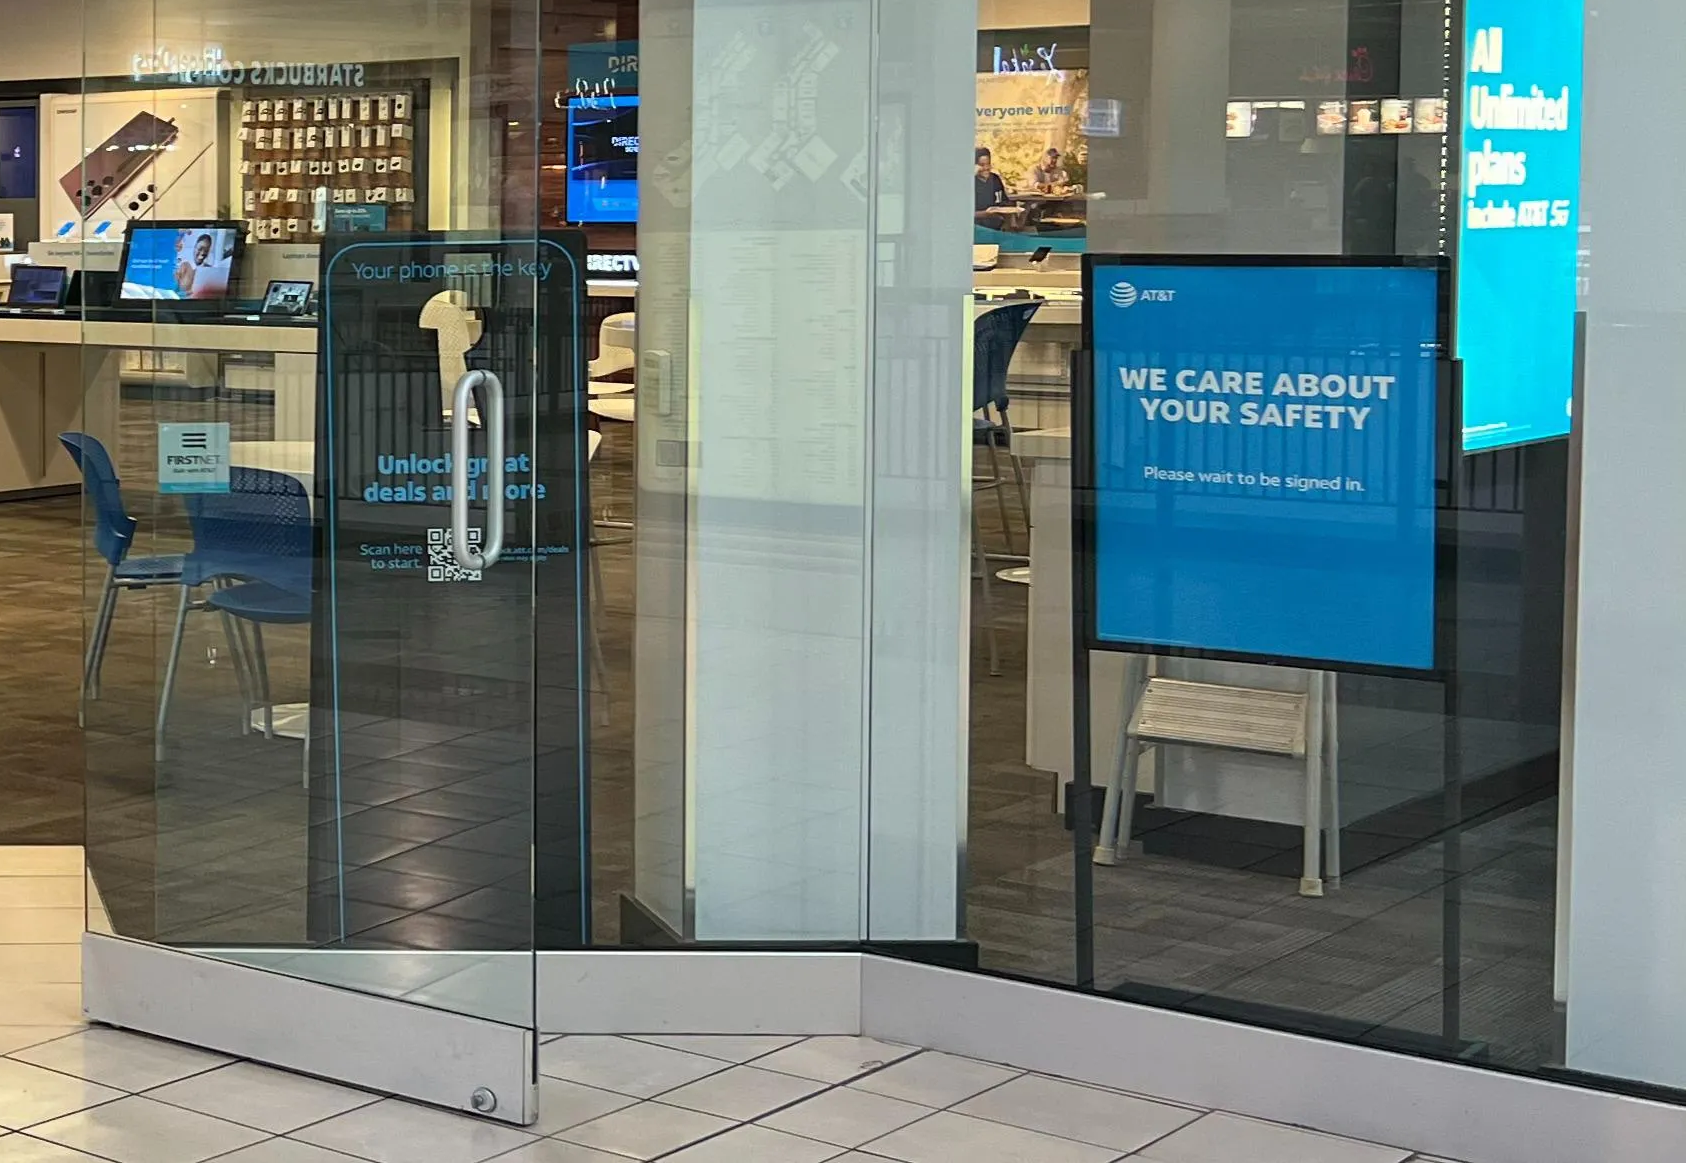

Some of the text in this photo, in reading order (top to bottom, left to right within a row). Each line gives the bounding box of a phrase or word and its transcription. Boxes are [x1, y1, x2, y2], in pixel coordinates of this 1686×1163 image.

[1470, 26, 1503, 73] All
[976, 103, 1071, 120] veryone wins
[1470, 83, 1569, 131] Unlimited
[1468, 138, 1527, 198] plans
[351, 260, 552, 282] Your phone is the key
[1140, 290, 1175, 301] AT&T
[1118, 367, 1395, 399] WE CARE ABOUT
[1140, 397, 1371, 430] YOUR SAFETY
[467, 453, 530, 479] grat
[1144, 466, 1194, 482] Please
[1198, 470, 1234, 484] wait
[1237, 472, 1256, 485] to
[1260, 473, 1281, 487] be
[1285, 475, 1341, 492] signed
[364, 481, 426, 502] deals
[482, 482, 546, 501] ore
[360, 543, 423, 556] Scan here
[371, 558, 385, 569] to
